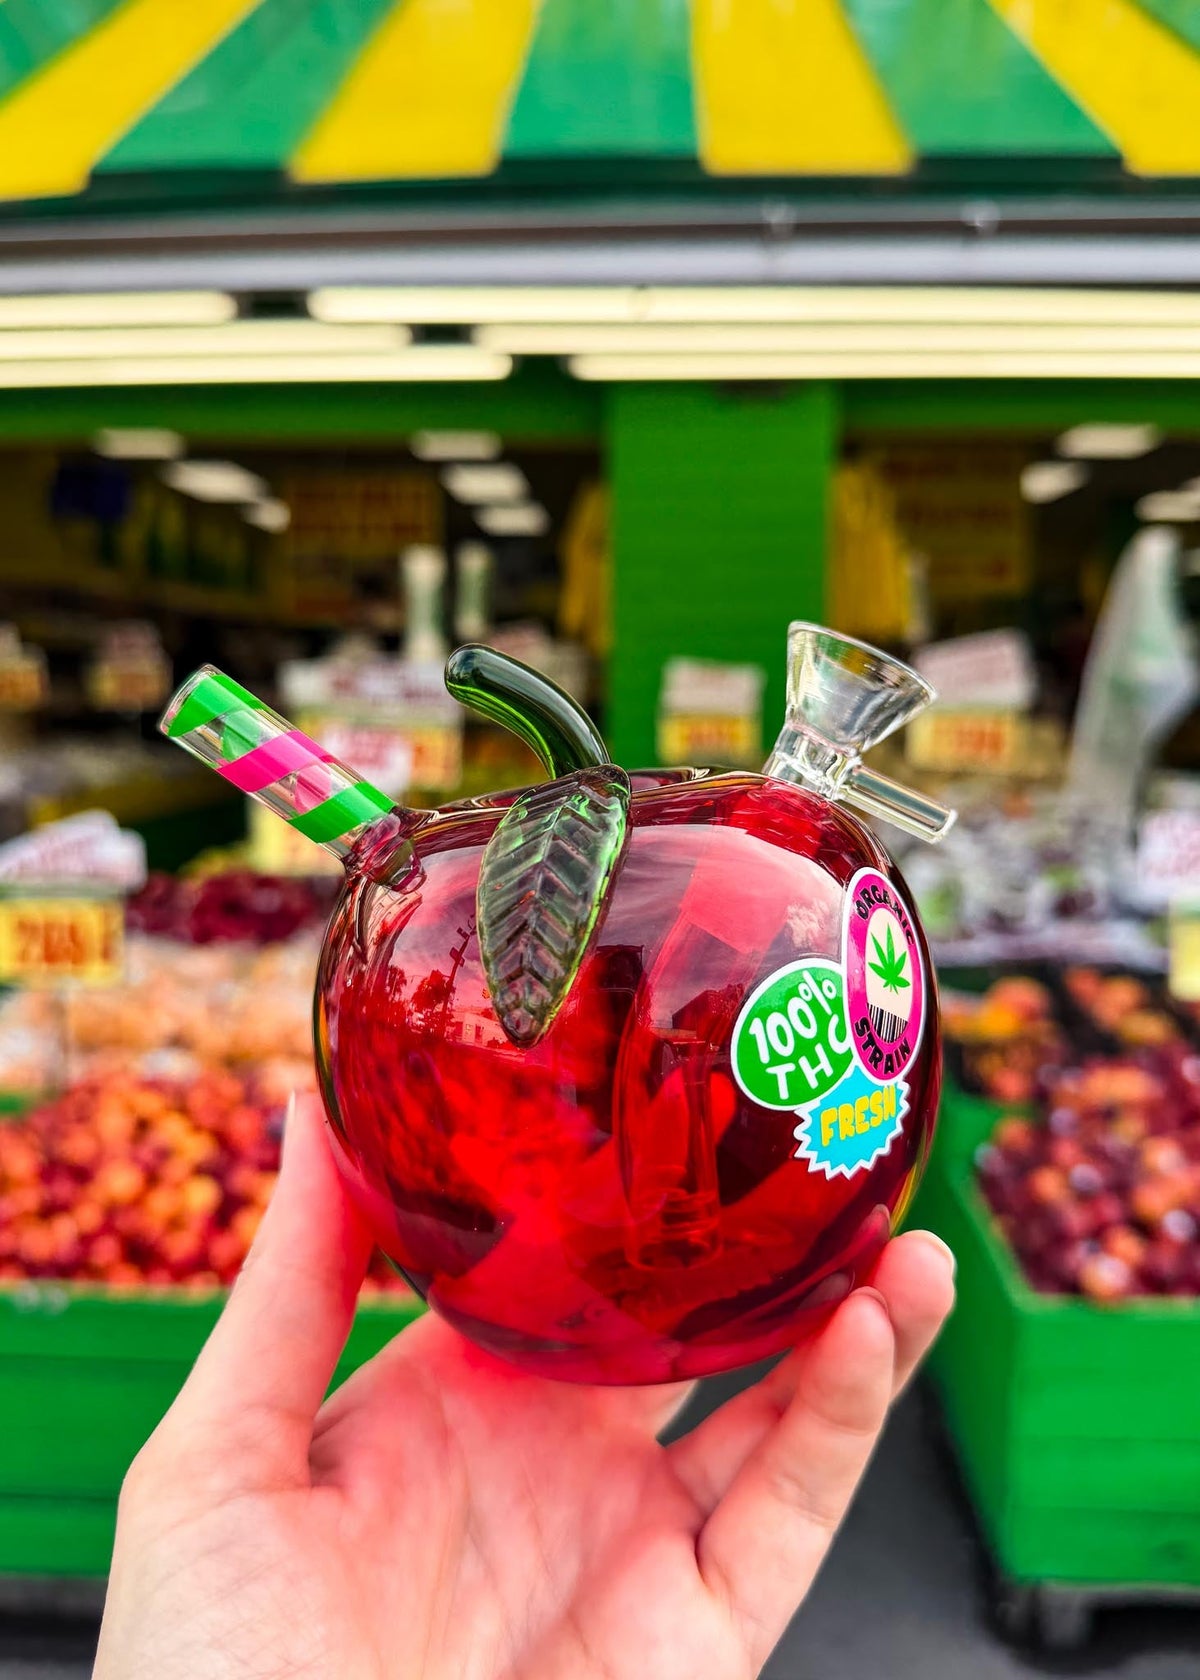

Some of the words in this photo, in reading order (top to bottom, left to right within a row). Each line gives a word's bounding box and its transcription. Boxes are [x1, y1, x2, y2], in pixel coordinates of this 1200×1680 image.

[856, 884, 915, 945] ORGANIC
[749, 970, 837, 1064] 100%
[855, 1017, 911, 1074] STRAIN
[766, 1014, 851, 1100] THC
[820, 1086, 897, 1147] FRESH
